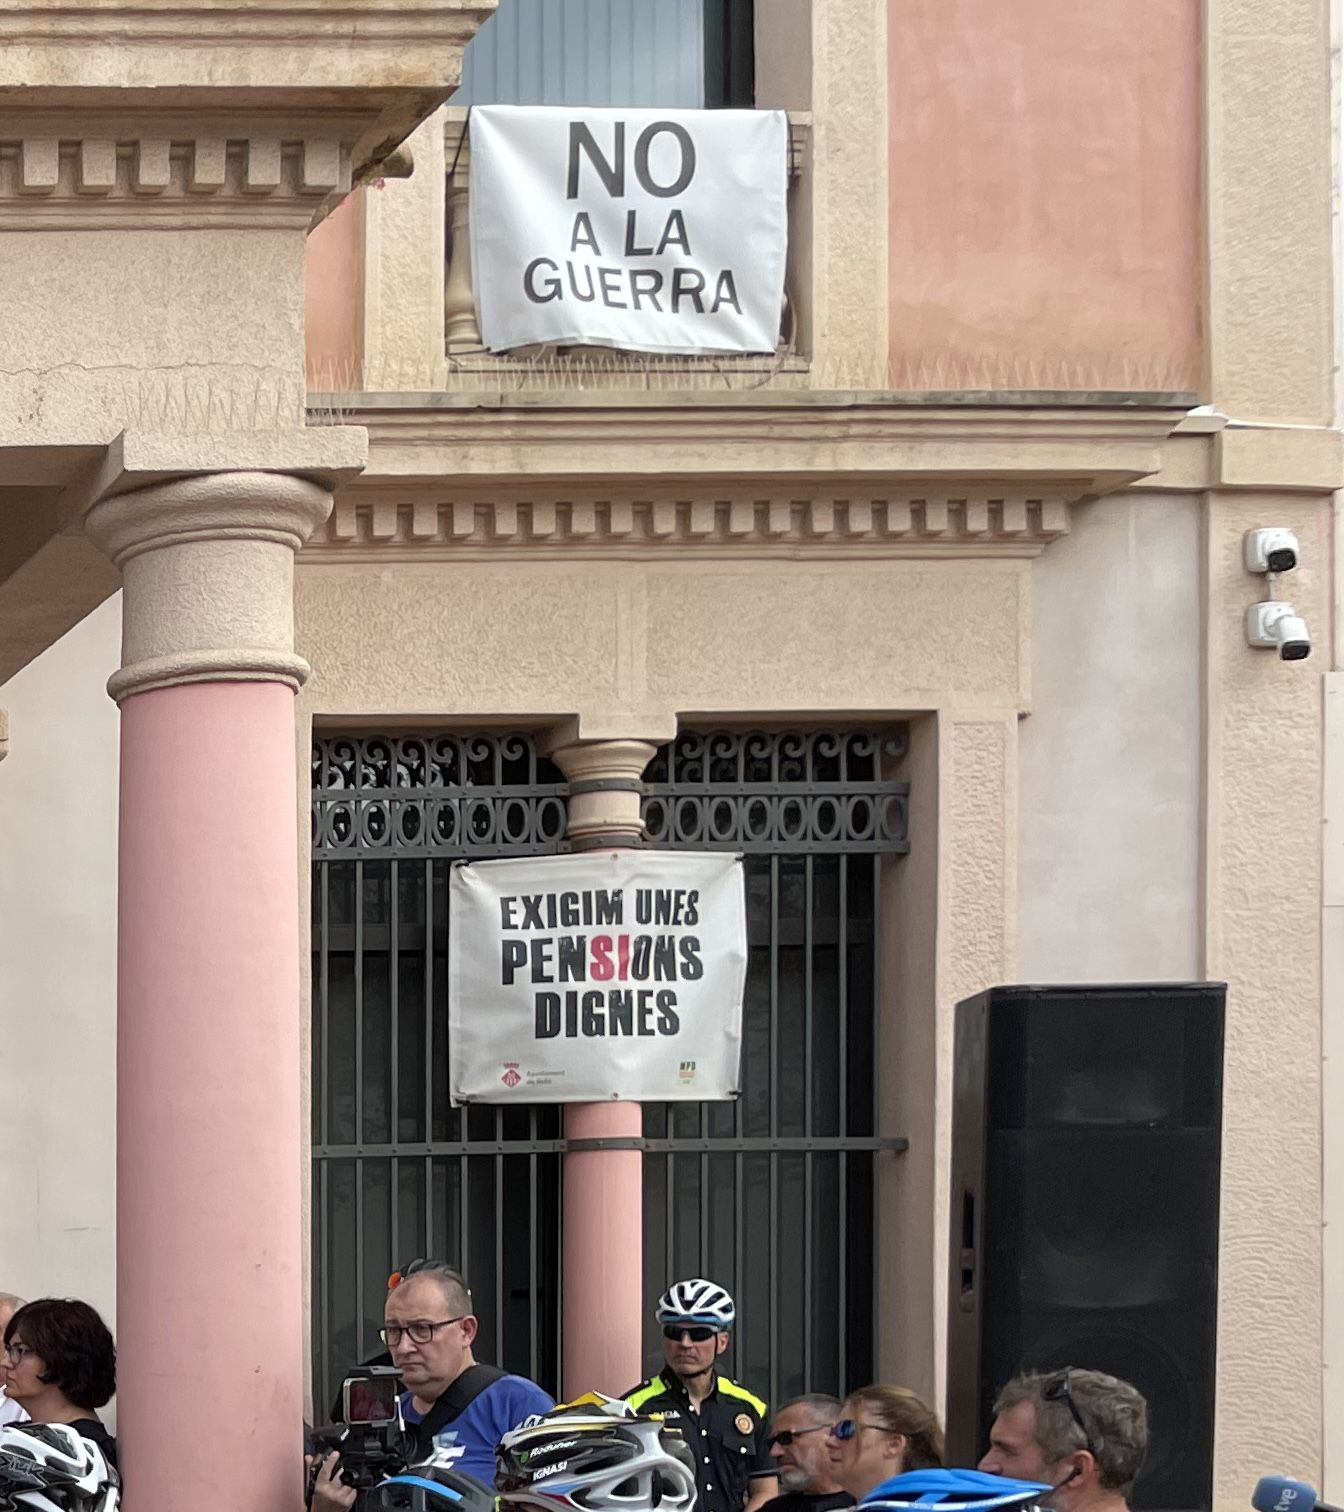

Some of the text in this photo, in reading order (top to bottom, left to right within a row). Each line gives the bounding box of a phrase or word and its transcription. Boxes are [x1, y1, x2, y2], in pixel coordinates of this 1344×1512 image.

[567, 121, 696, 199] NO
[570, 209, 691, 256] A LA
[523, 257, 743, 315] GUERRA
[500, 889, 700, 930] EXIGIM UNES
[502, 934, 704, 985] PENSIONS
[535, 989, 681, 1039] DIGNES
